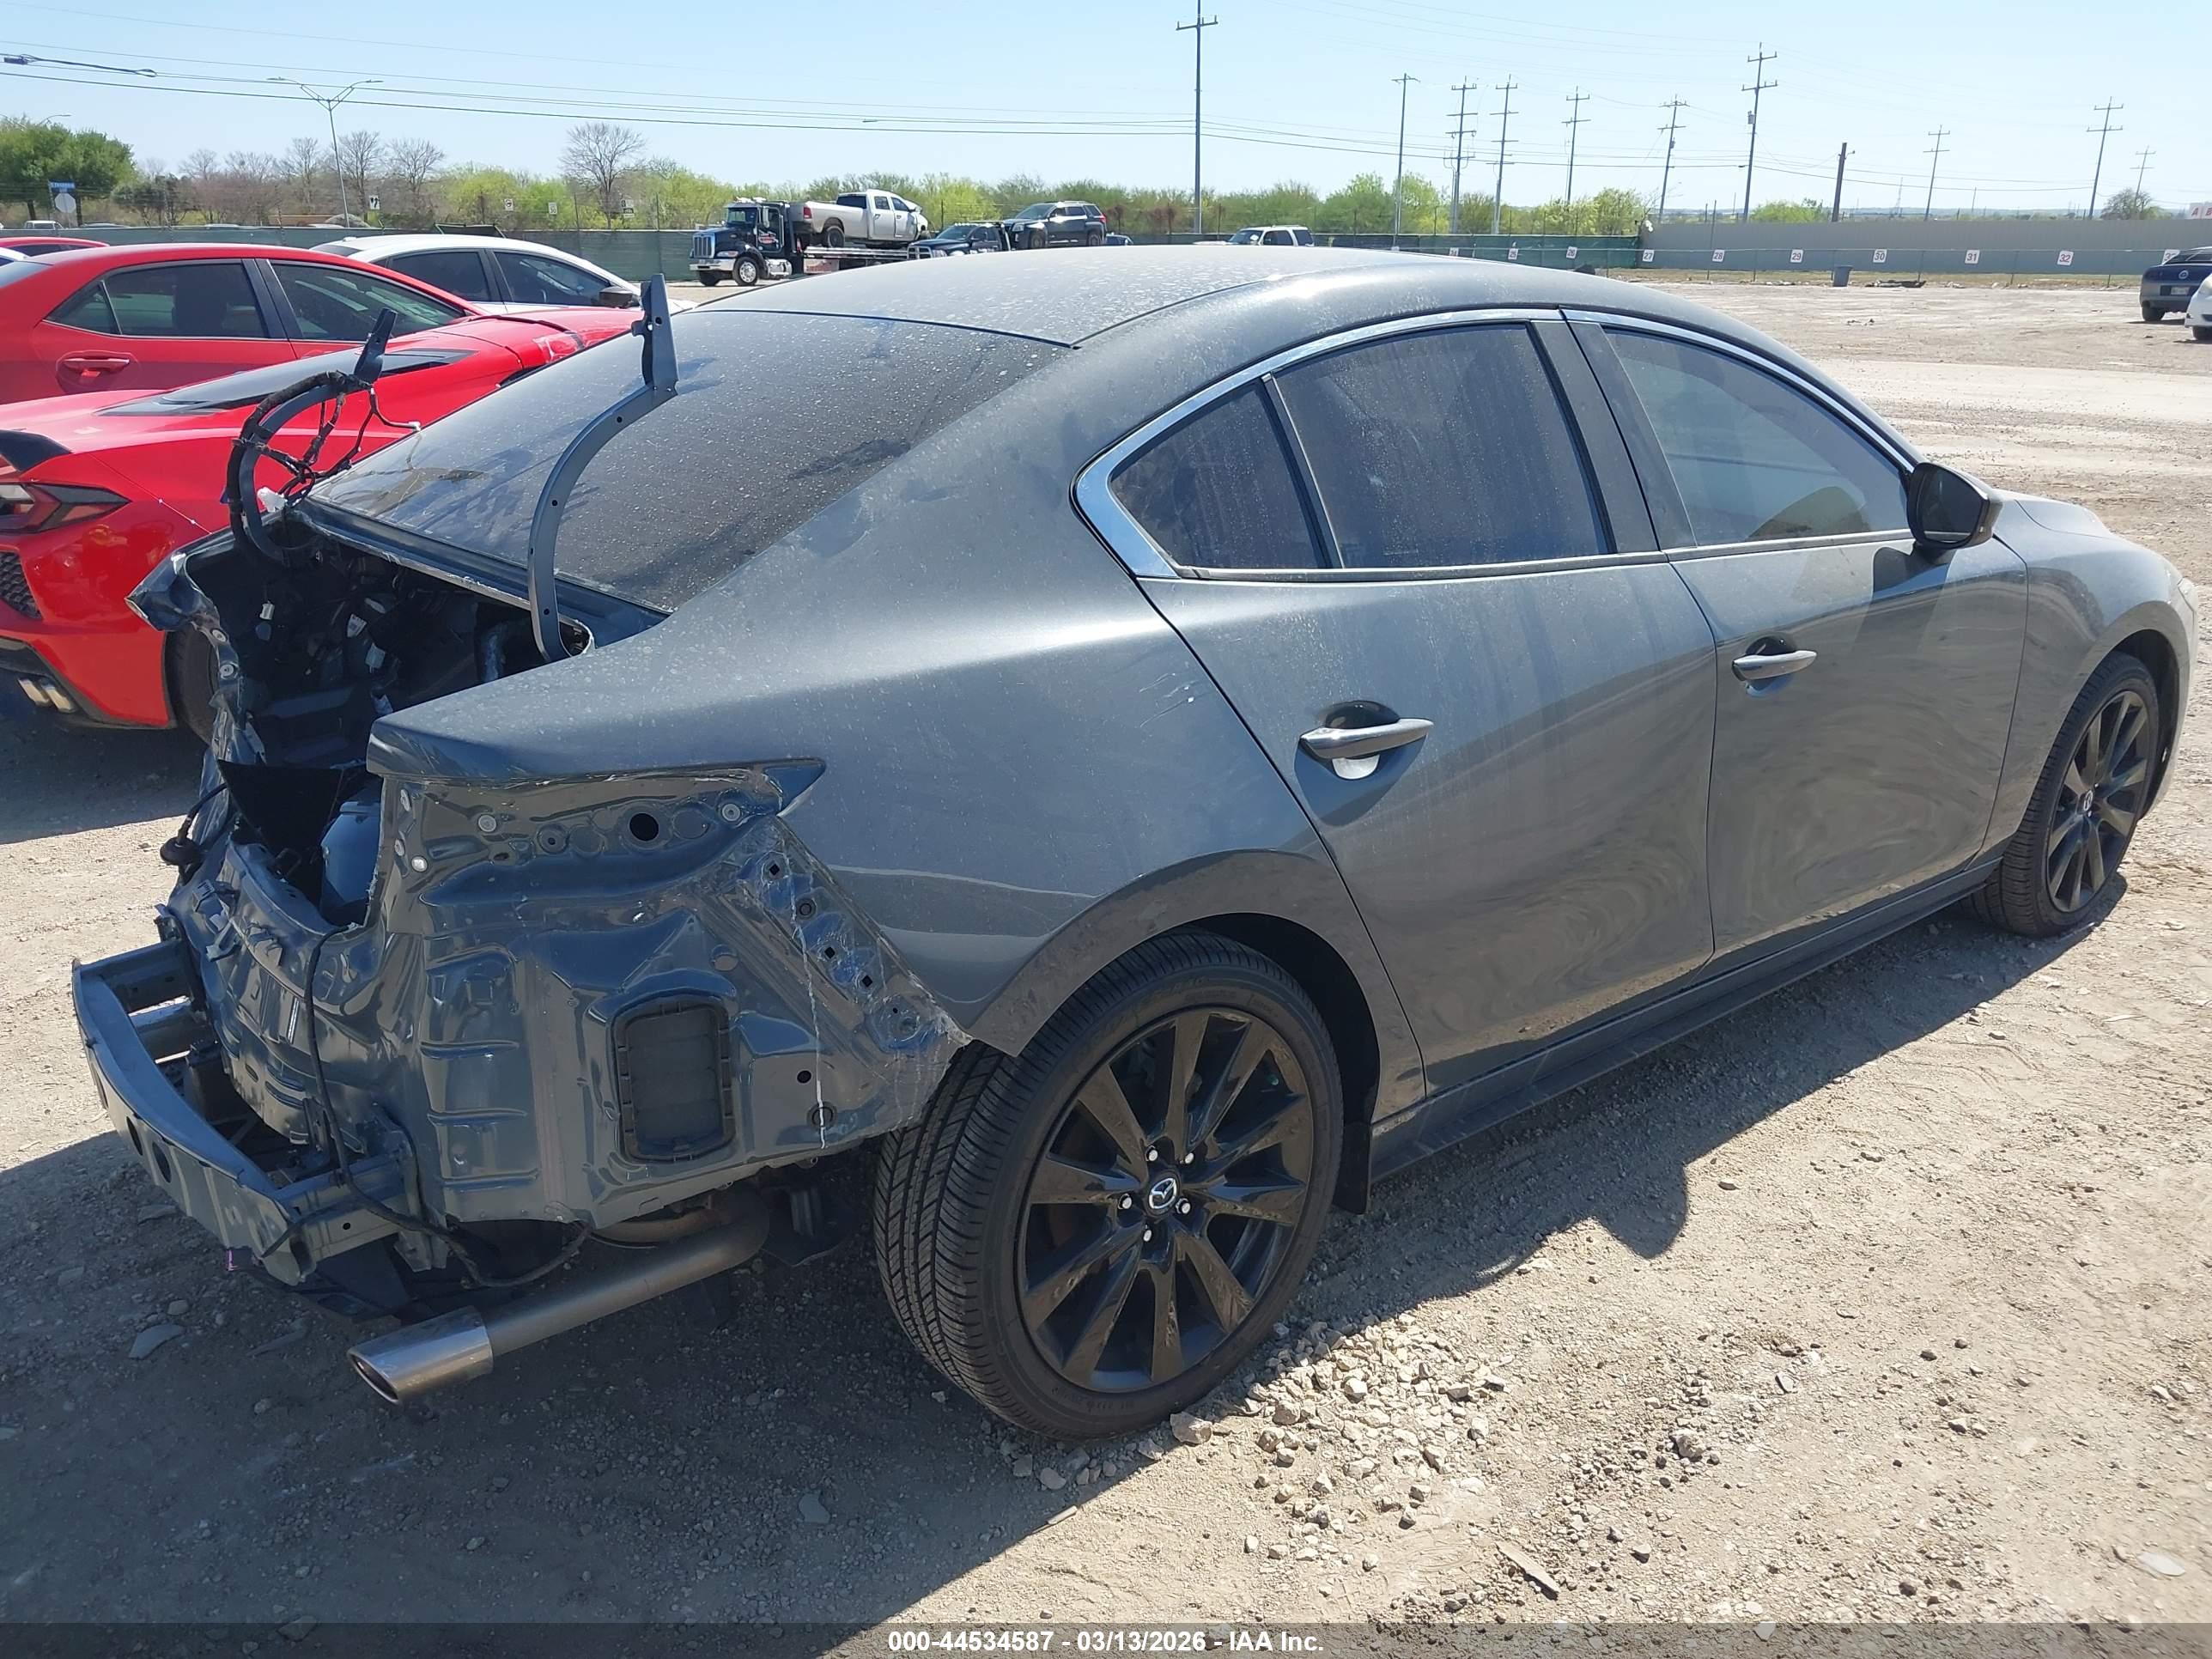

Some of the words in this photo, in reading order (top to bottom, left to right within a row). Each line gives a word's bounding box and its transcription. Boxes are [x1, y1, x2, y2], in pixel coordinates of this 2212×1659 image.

[1792, 252, 1802, 261] 29
[1874, 252, 1885, 261] 30
[1966, 252, 1977, 262] 31
[2059, 253, 2070, 263] 32
